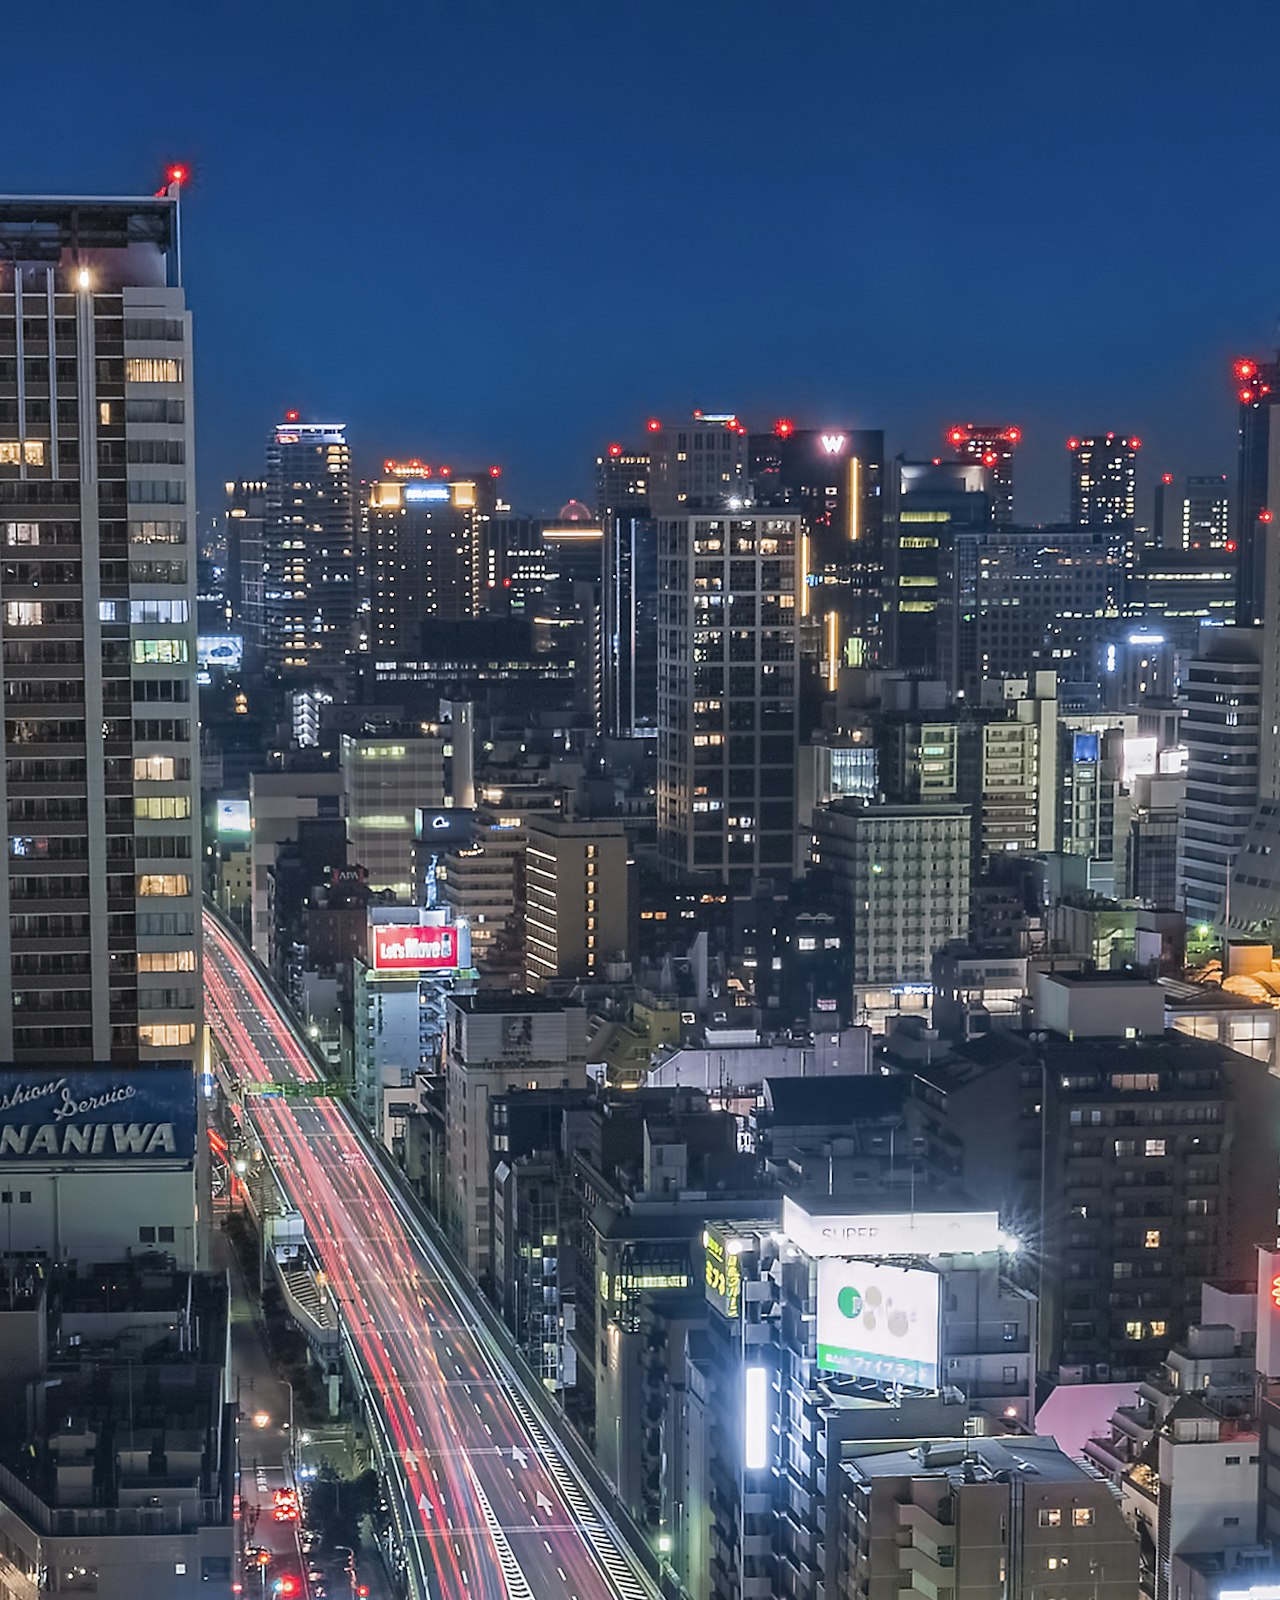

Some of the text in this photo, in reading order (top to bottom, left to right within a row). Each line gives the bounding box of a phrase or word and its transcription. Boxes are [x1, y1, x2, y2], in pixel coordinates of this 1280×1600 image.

[821, 434, 845, 453] W
[53, 1085, 137, 1122] Service
[0, 1122, 177, 1155] NANIWA
